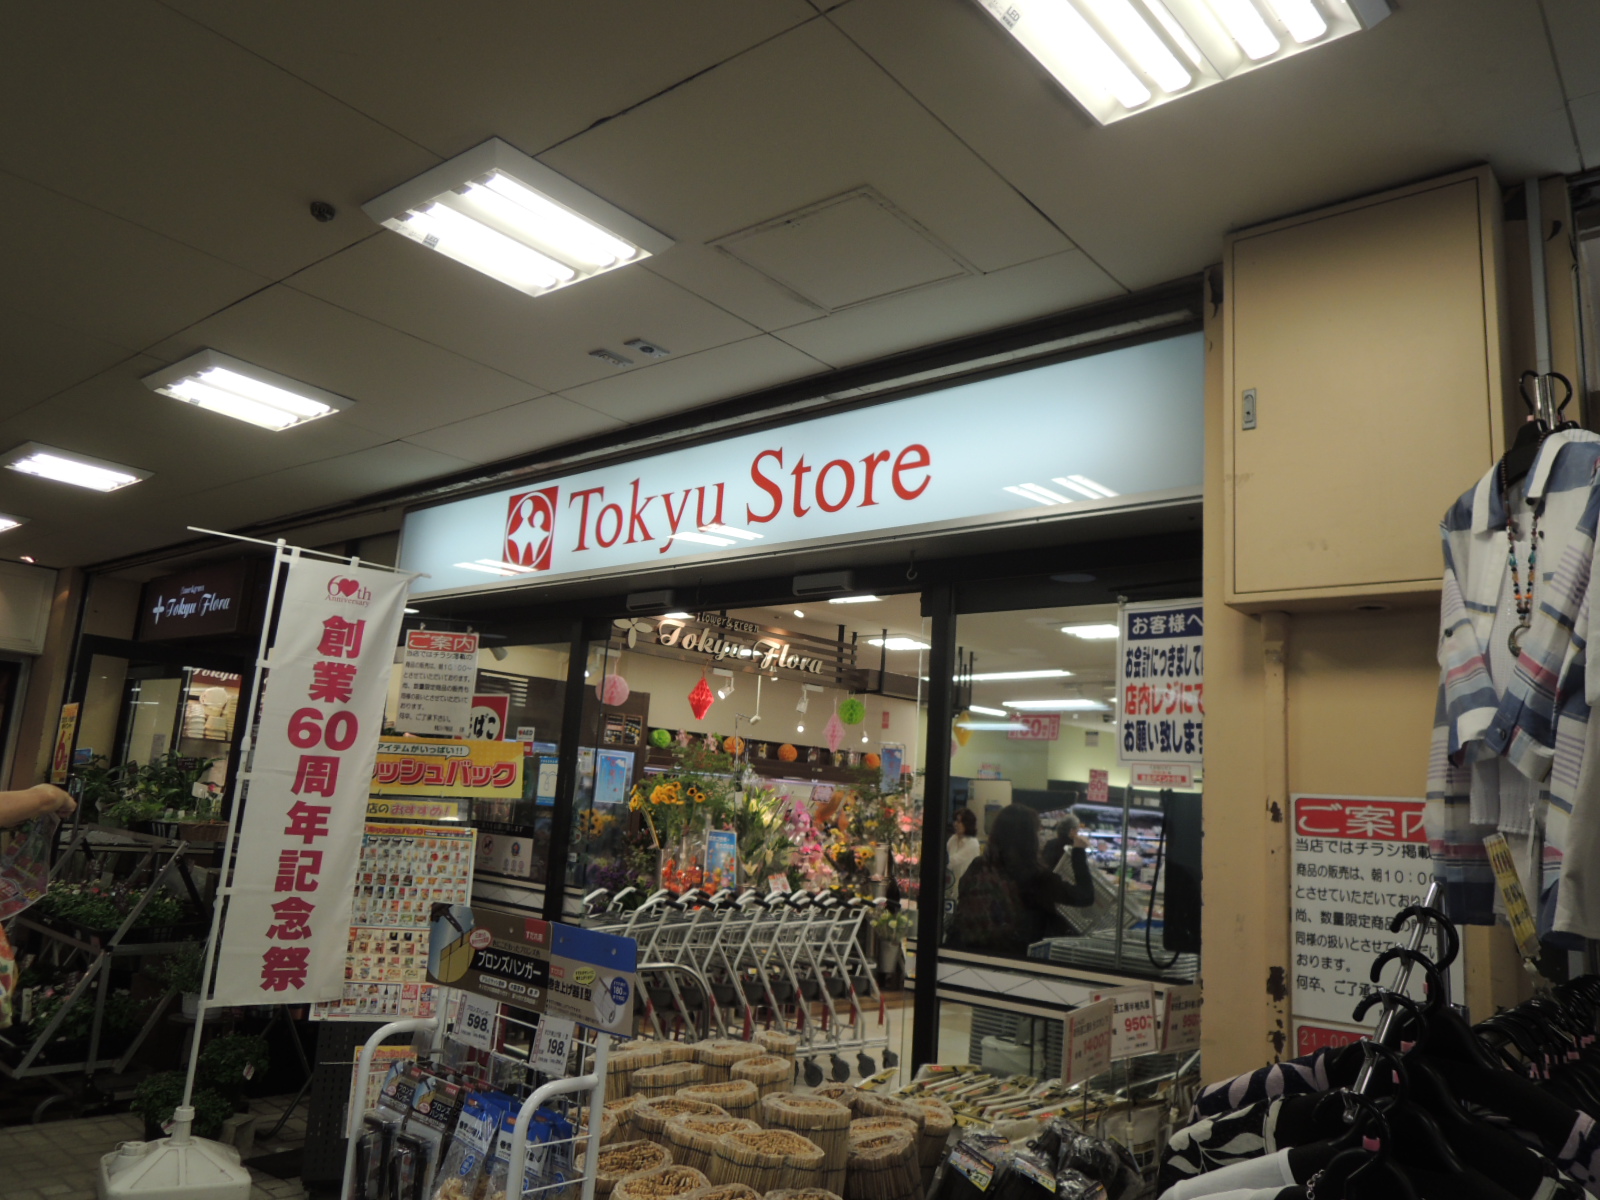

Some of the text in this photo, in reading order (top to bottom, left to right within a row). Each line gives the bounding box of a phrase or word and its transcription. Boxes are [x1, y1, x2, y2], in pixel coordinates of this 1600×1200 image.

[1006, 6, 1020, 22] LED
[568, 443, 932, 554] Tokyu Store
[166, 593, 231, 619] Tokyu Flora
[325, 594, 371, 608] Anniversary
[409, 633, 476, 652] ご案内
[658, 619, 824, 675] Tokyu Flora
[1296, 953, 1351, 973] おります。
[467, 1013, 488, 1032] 598
[547, 1038, 565, 1056] 198
